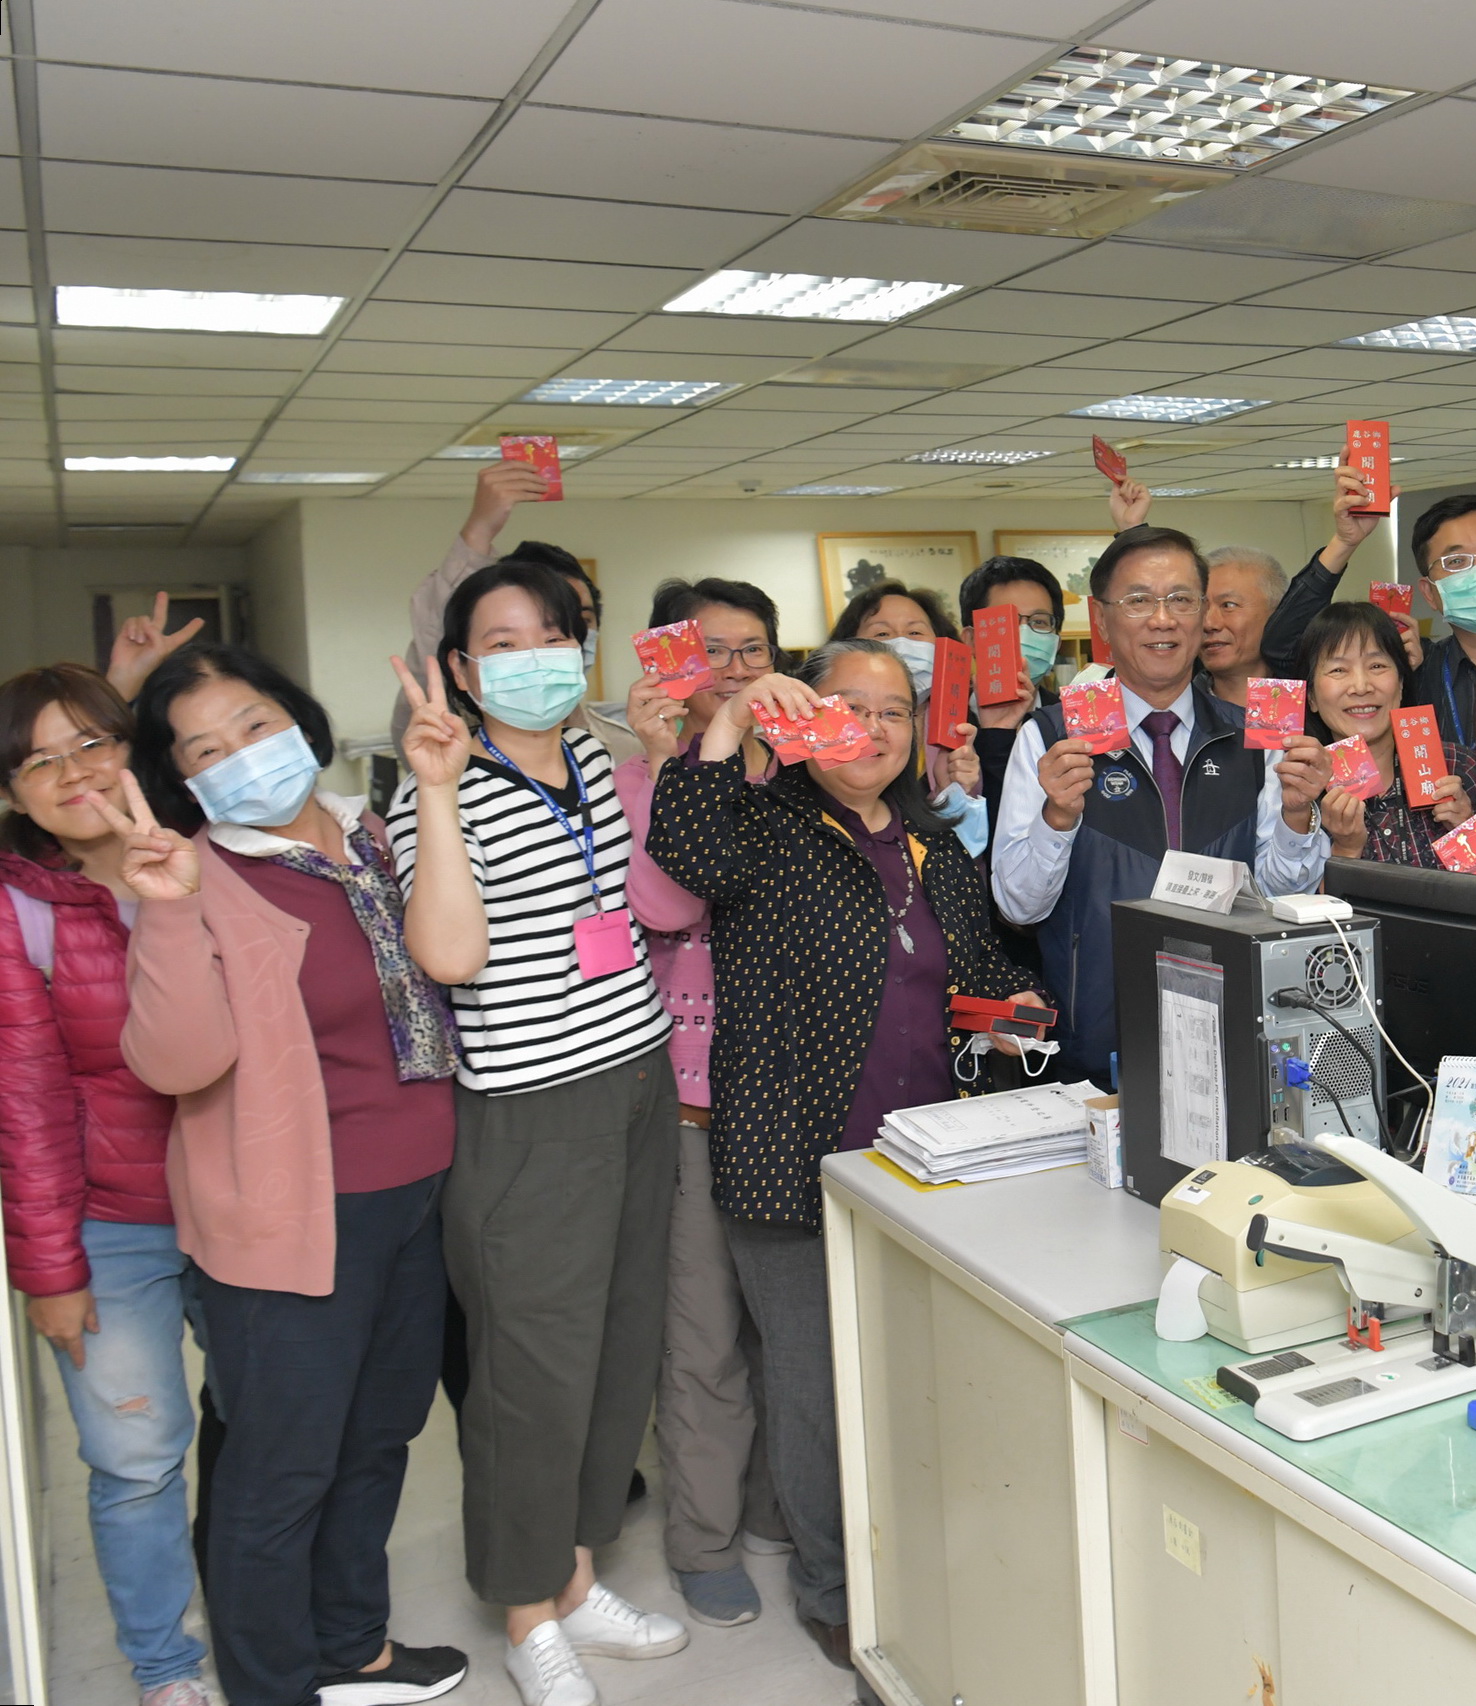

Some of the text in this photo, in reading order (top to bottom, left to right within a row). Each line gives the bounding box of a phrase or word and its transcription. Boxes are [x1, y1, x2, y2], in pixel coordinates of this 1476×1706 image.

[988, 644, 1003, 694] 開山廟
[1399, 716, 1429, 728] 鹿谷鄉
[1413, 744, 1436, 796] 開山廟
[1446, 1076, 1472, 1089] 2021
